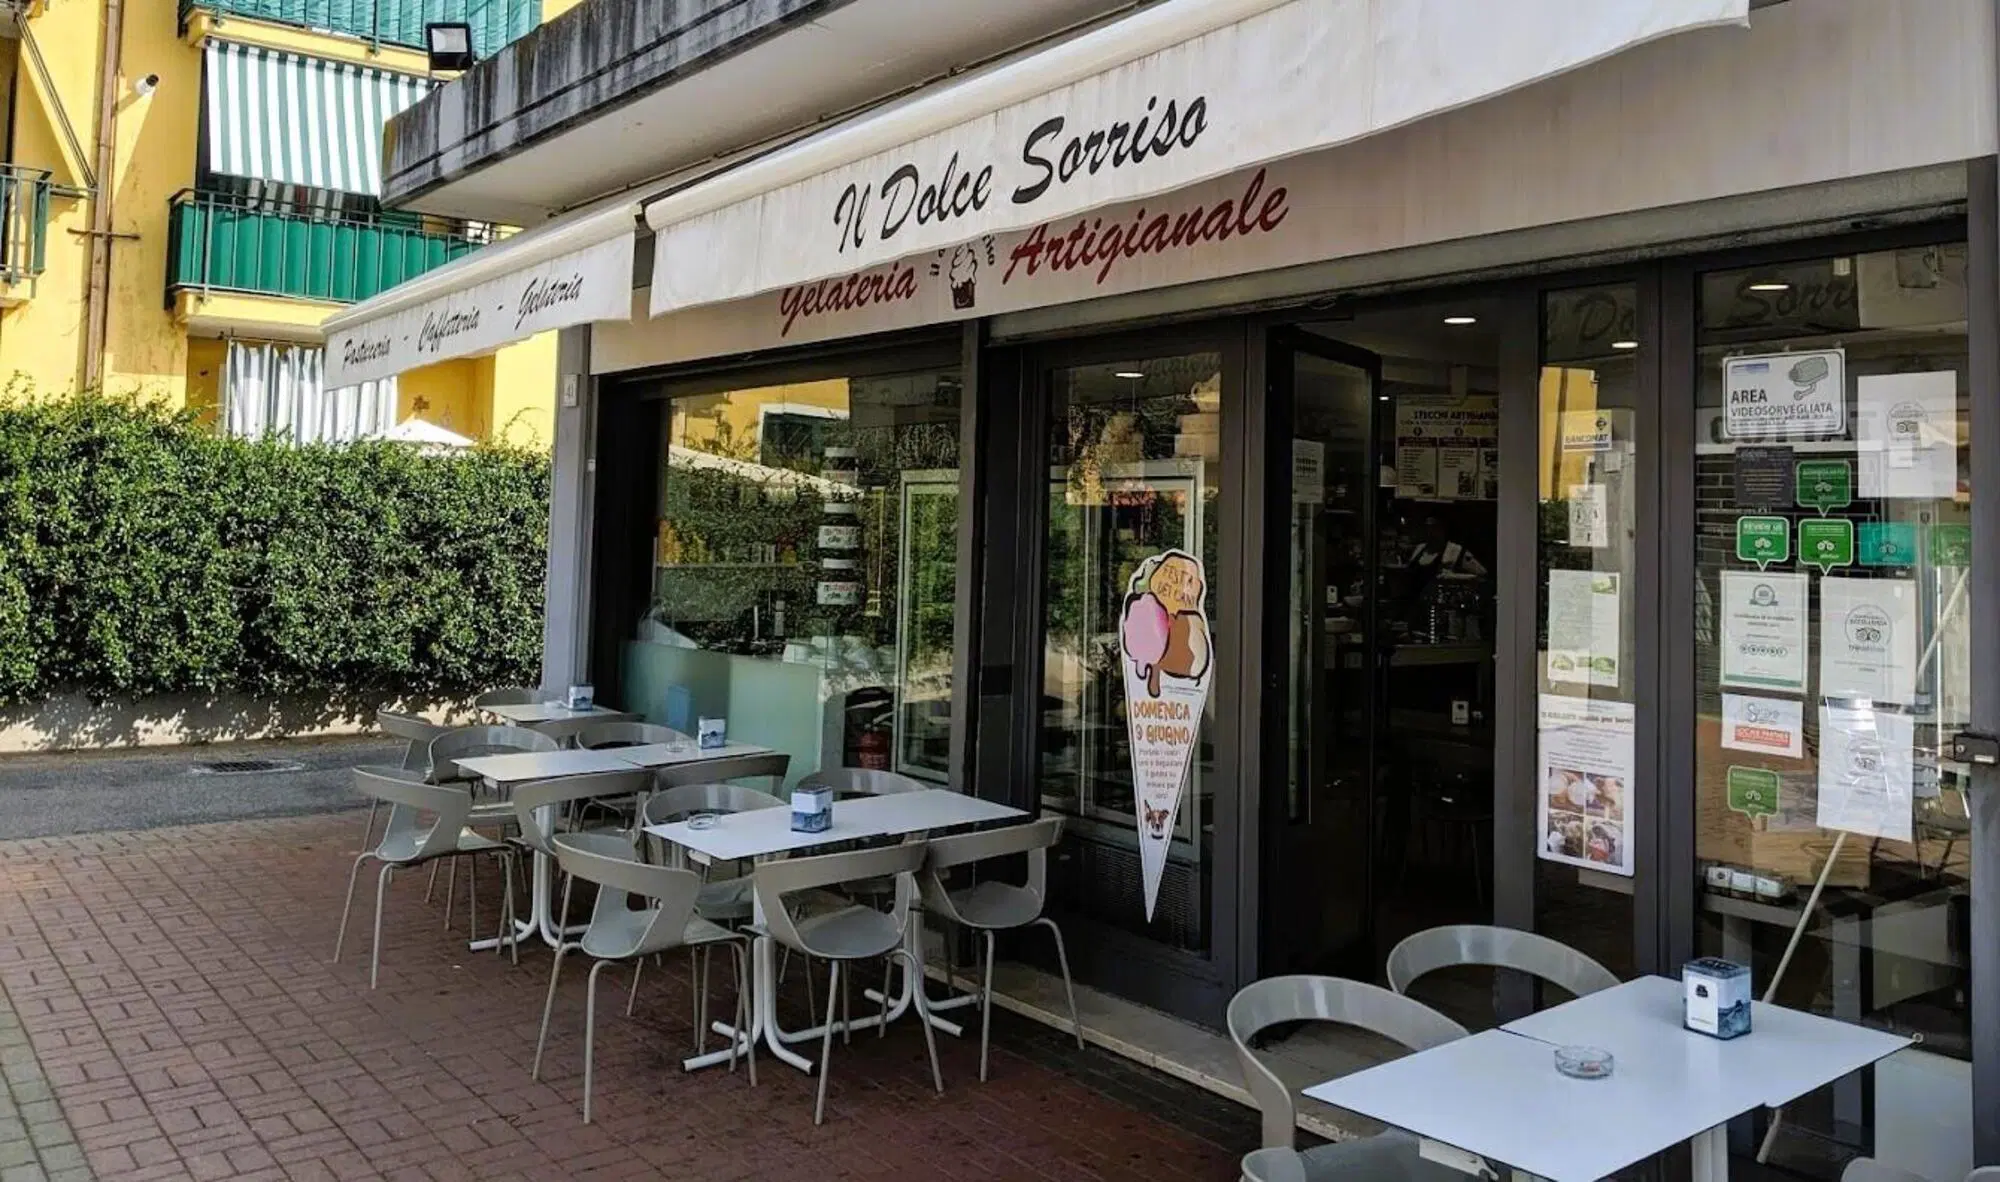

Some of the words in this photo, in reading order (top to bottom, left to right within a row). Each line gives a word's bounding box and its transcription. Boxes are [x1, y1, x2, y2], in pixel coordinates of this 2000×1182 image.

[834, 182, 871, 254] Il
[880, 151, 994, 240] Dolce
[1011, 96, 1208, 205] Sorriso
[1003, 168, 1289, 285] Artigianale
[343, 334, 392, 371] Pasticceria
[418, 305, 481, 353] Caffetteria
[515, 272, 584, 330] Gelateria
[1731, 388, 1768, 404] AREA
[1731, 402, 1834, 417] VIDEOSORVEGLIATA
[1565, 433, 1609, 443] BANCOMAT
[1133, 701, 1191, 721] DOMENICA
[1146, 726, 1191, 746] GIUGNO
